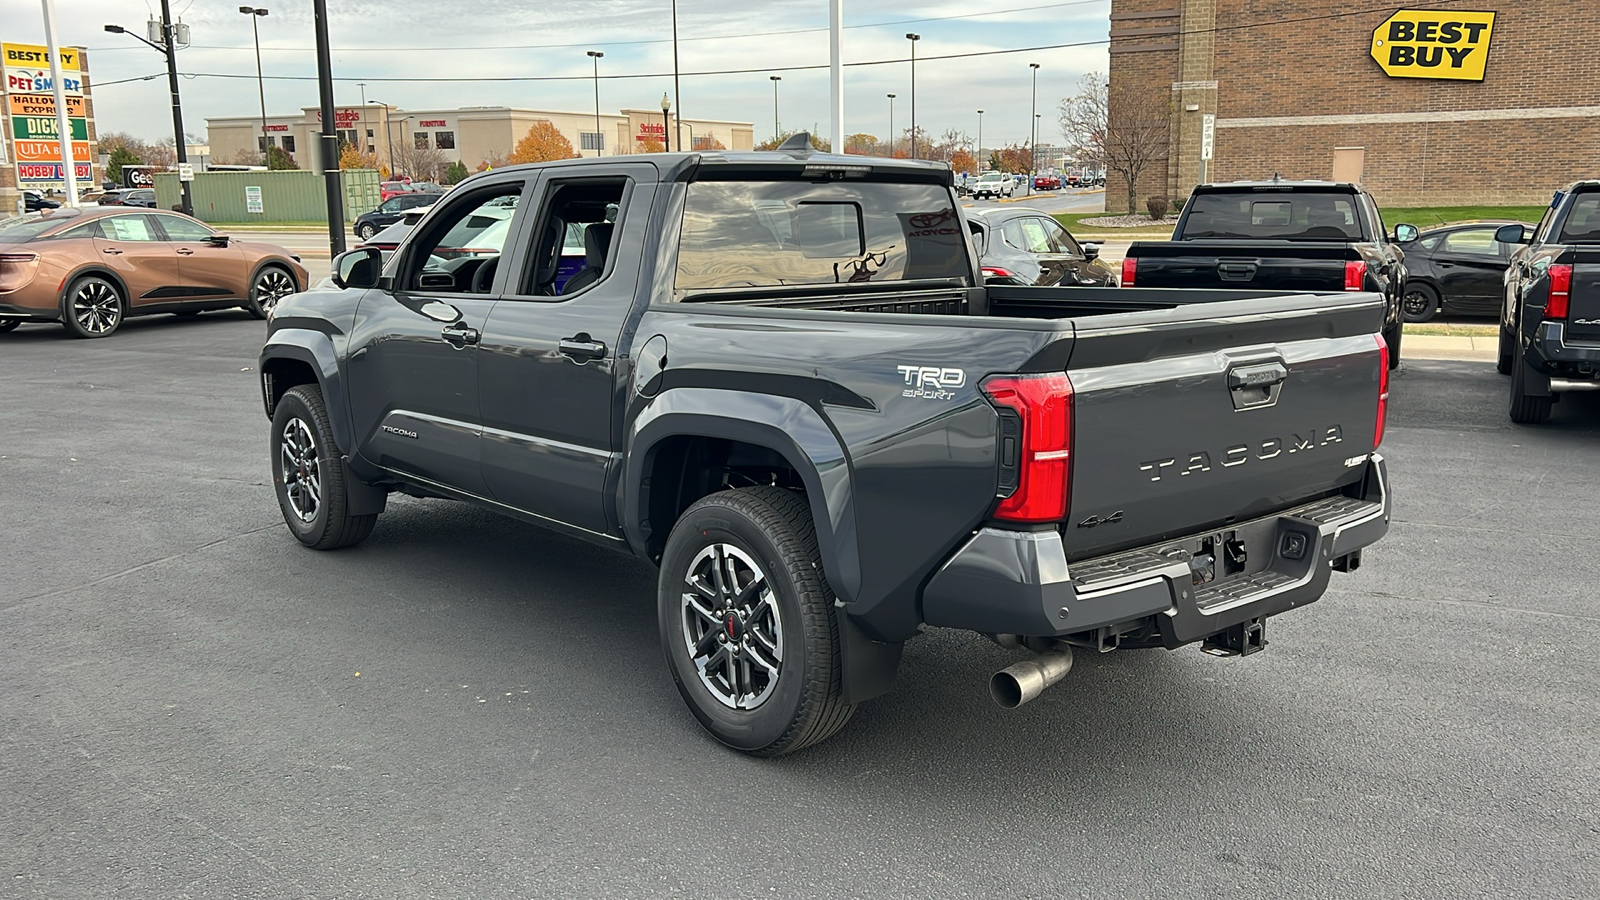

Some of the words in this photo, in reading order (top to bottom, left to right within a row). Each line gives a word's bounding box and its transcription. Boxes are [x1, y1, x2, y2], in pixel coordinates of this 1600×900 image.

[1388, 21, 1488, 44] BEST
[7, 50, 41, 61] BEST
[44, 53, 73, 64] BY
[1388, 45, 1475, 68] BUY
[8, 75, 80, 92] PETSMRT
[13, 96, 81, 106] HALLOWEN
[23, 106, 74, 115] EXPRS
[26, 118, 74, 134] DICKS
[20, 143, 51, 155] ULTA
[53, 147, 88, 155] BUTY
[19, 165, 54, 178] HOBBY
[58, 165, 89, 177] LBY
[131, 171, 153, 184] Gee
[897, 365, 966, 388] TRD
[902, 389, 955, 400] SPORT
[382, 425, 419, 439] TACOMA
[1139, 424, 1343, 481] TACOMA
